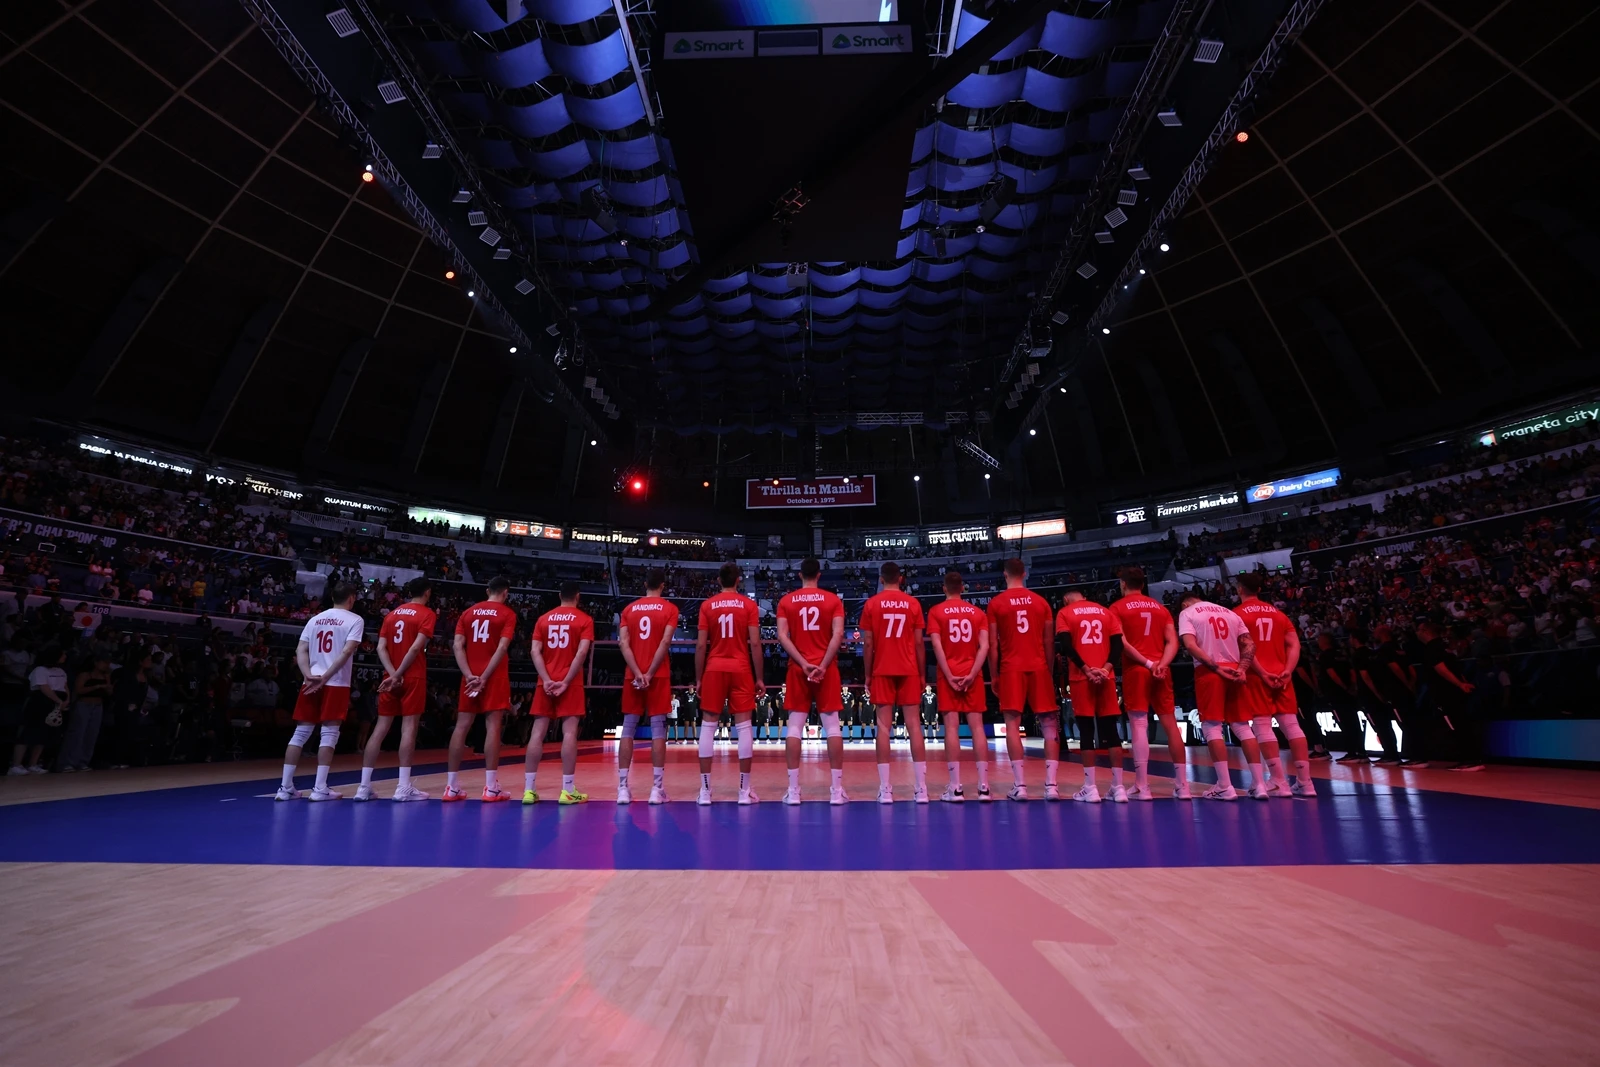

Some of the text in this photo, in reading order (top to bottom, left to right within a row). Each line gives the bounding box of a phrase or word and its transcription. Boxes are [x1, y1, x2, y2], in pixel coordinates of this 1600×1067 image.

[694, 39, 744, 53] Smart
[853, 33, 904, 48] Smart
[1501, 408, 1599, 440] araneta city
[803, 484, 817, 495] In
[1279, 482, 1302, 493] Dairy
[323, 496, 395, 514] QUANTUM SKYVIEW
[1126, 510, 1145, 518] TACO
[1157, 494, 1239, 517] Farmers Market
[571, 530, 611, 544] Farmers
[865, 537, 909, 548] Gateway
[93, 606, 109, 615] 108
[881, 600, 909, 609] KAPLAN
[944, 606, 960, 615] CAN
[639, 616, 651, 640] 9
[718, 613, 734, 639] 11
[799, 606, 820, 631] 12
[883, 614, 907, 638] 77
[949, 618, 973, 643] 59
[1016, 610, 1030, 634] 5
[1140, 612, 1152, 636] 7
[1208, 616, 1229, 640] 19
[1255, 617, 1273, 642] 17
[317, 630, 334, 653] 16
[393, 620, 405, 644] 3
[471, 619, 490, 643] 14
[547, 625, 570, 649] 55
[1080, 619, 1104, 645] 23
